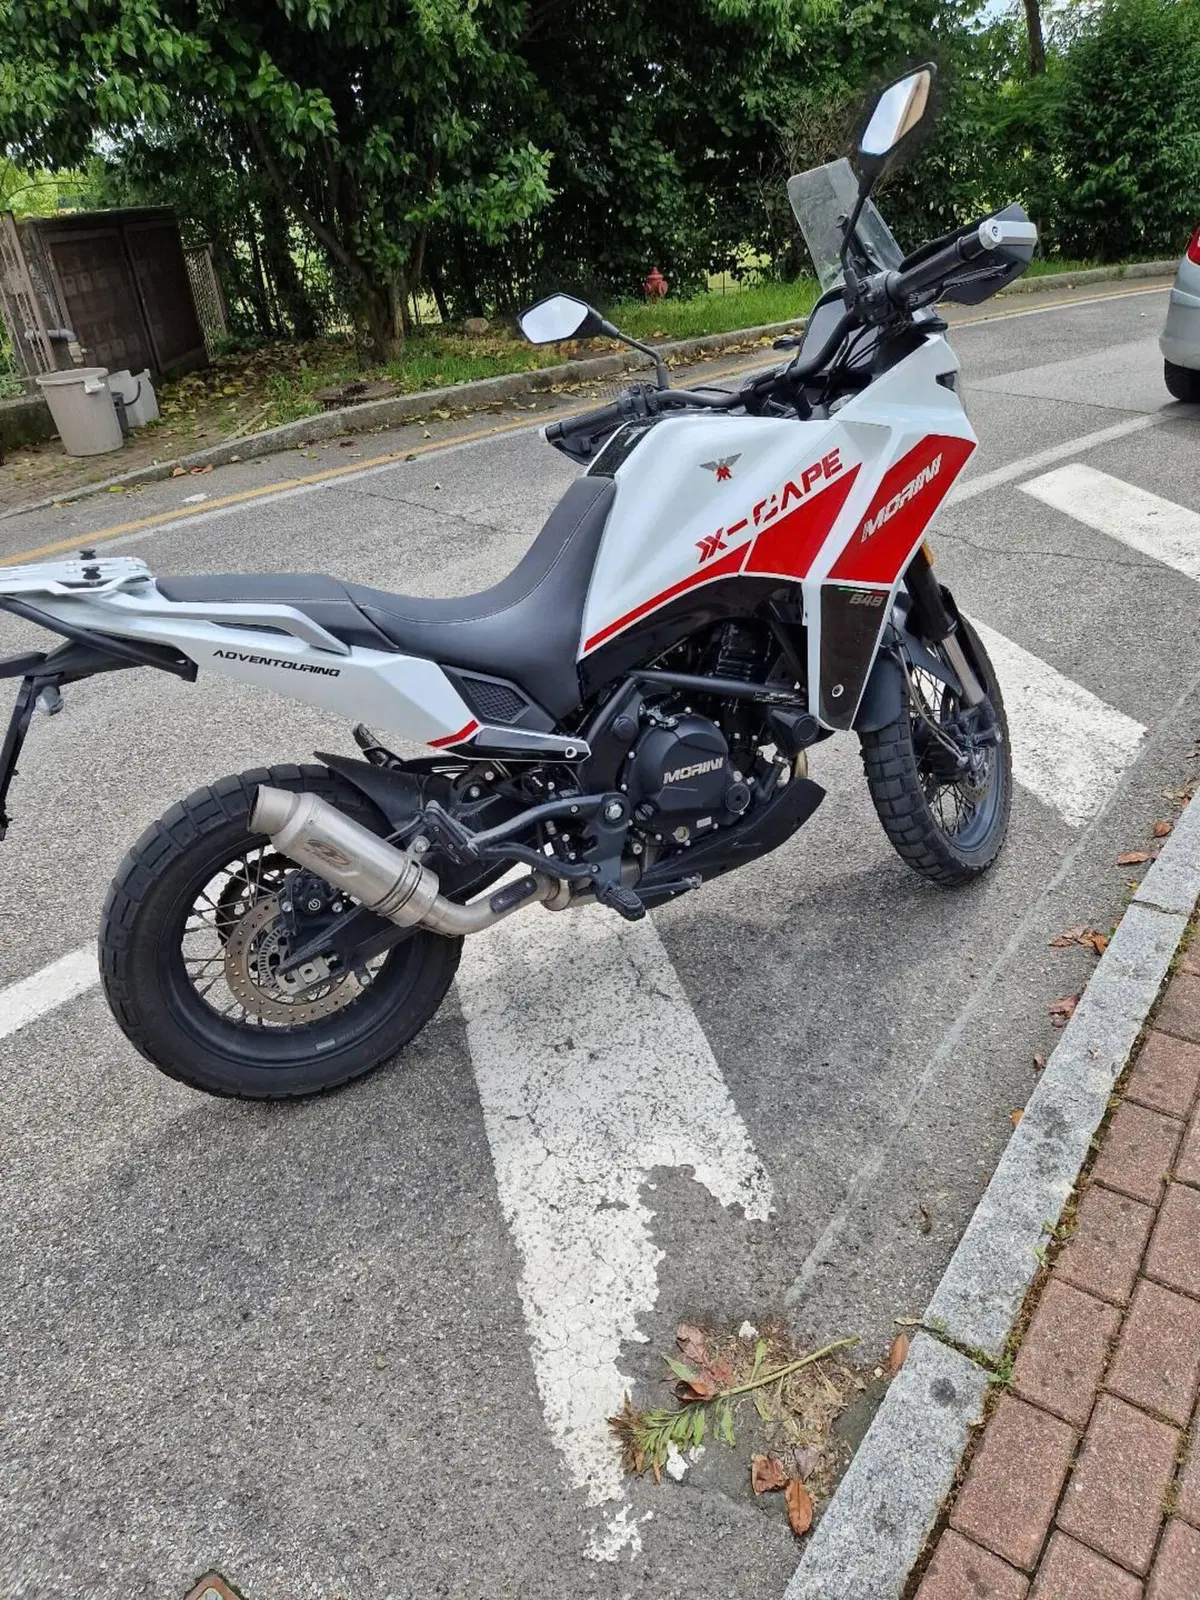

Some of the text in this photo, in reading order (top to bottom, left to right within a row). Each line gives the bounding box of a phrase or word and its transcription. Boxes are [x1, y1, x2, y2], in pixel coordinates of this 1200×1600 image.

[694, 447, 843, 564] X-CAPE
[860, 452, 943, 543] MORINI
[212, 649, 341, 678] ADVENTOURING
[662, 757, 724, 785] MORINI
